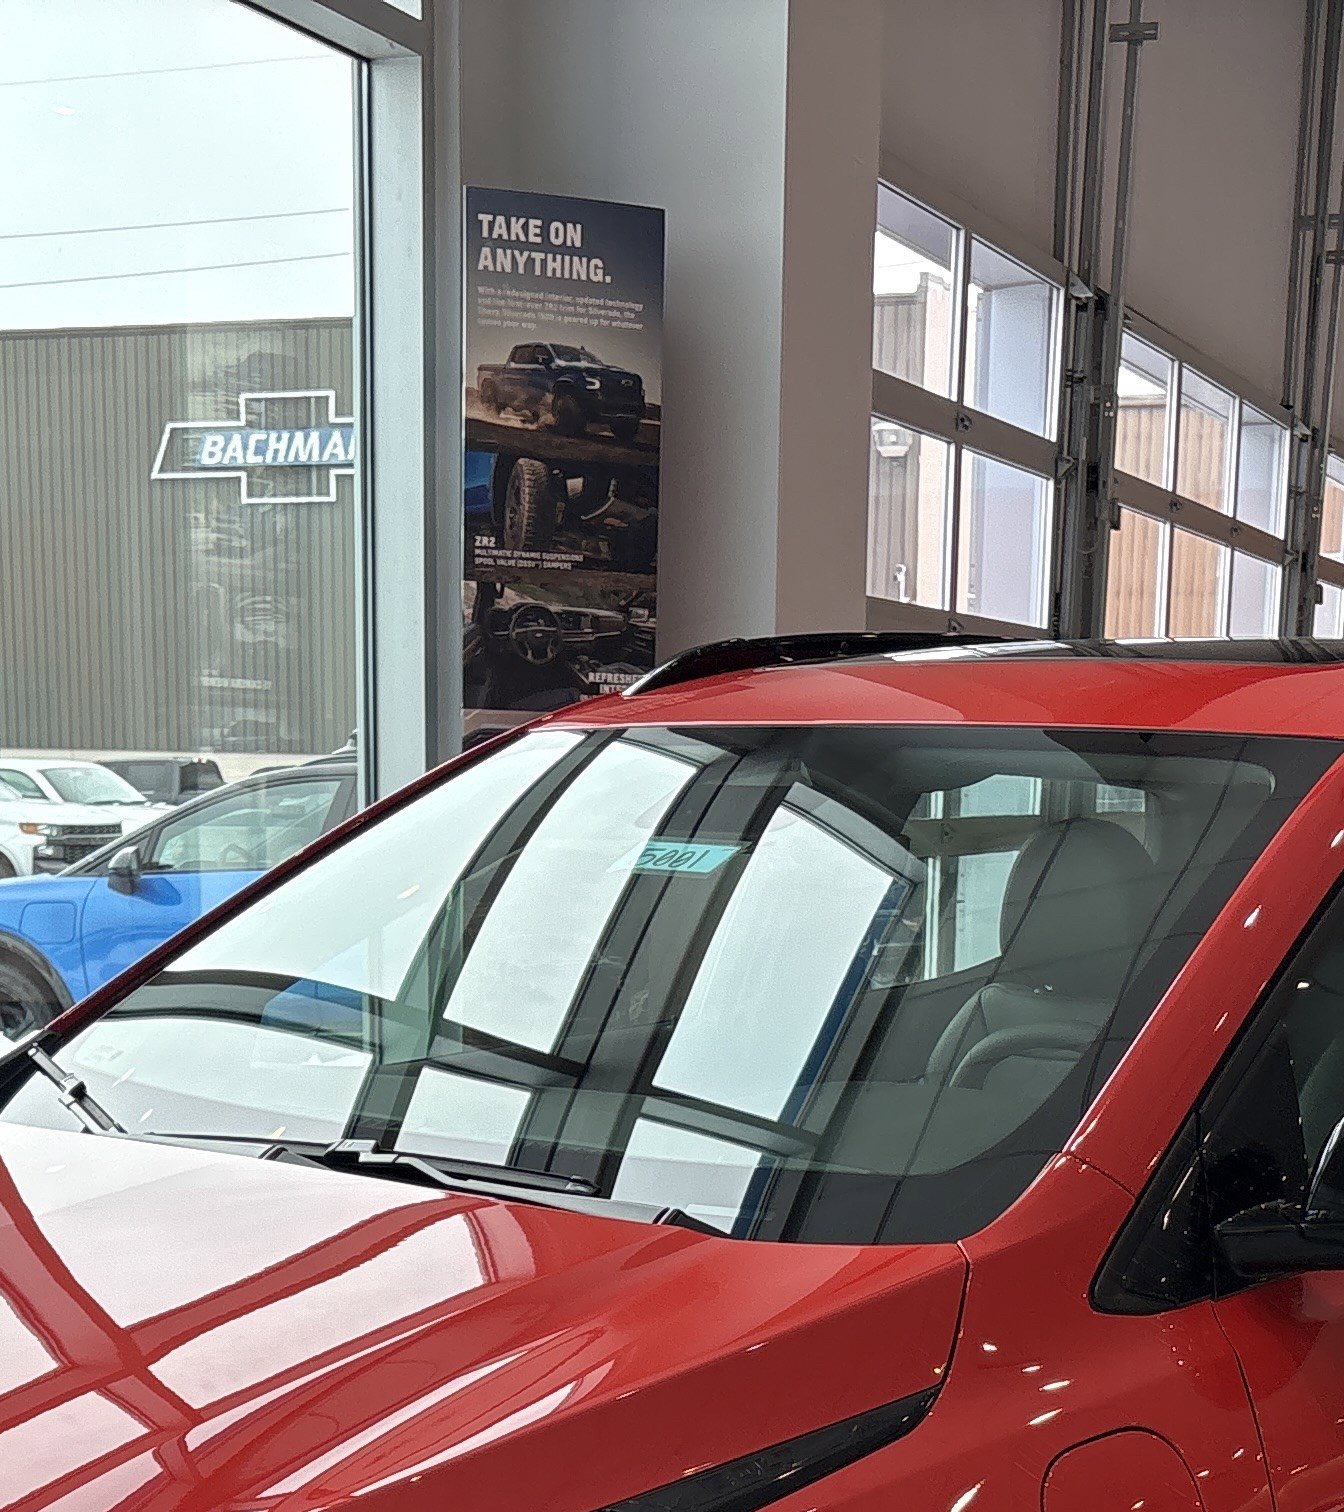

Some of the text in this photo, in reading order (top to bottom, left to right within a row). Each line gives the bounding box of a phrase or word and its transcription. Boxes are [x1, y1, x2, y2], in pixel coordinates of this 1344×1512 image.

[477, 213, 583, 249] TAKE ON
[476, 246, 613, 284] ANYTHING.
[474, 535, 496, 548] ZR2
[636, 848, 711, 869] 5001
